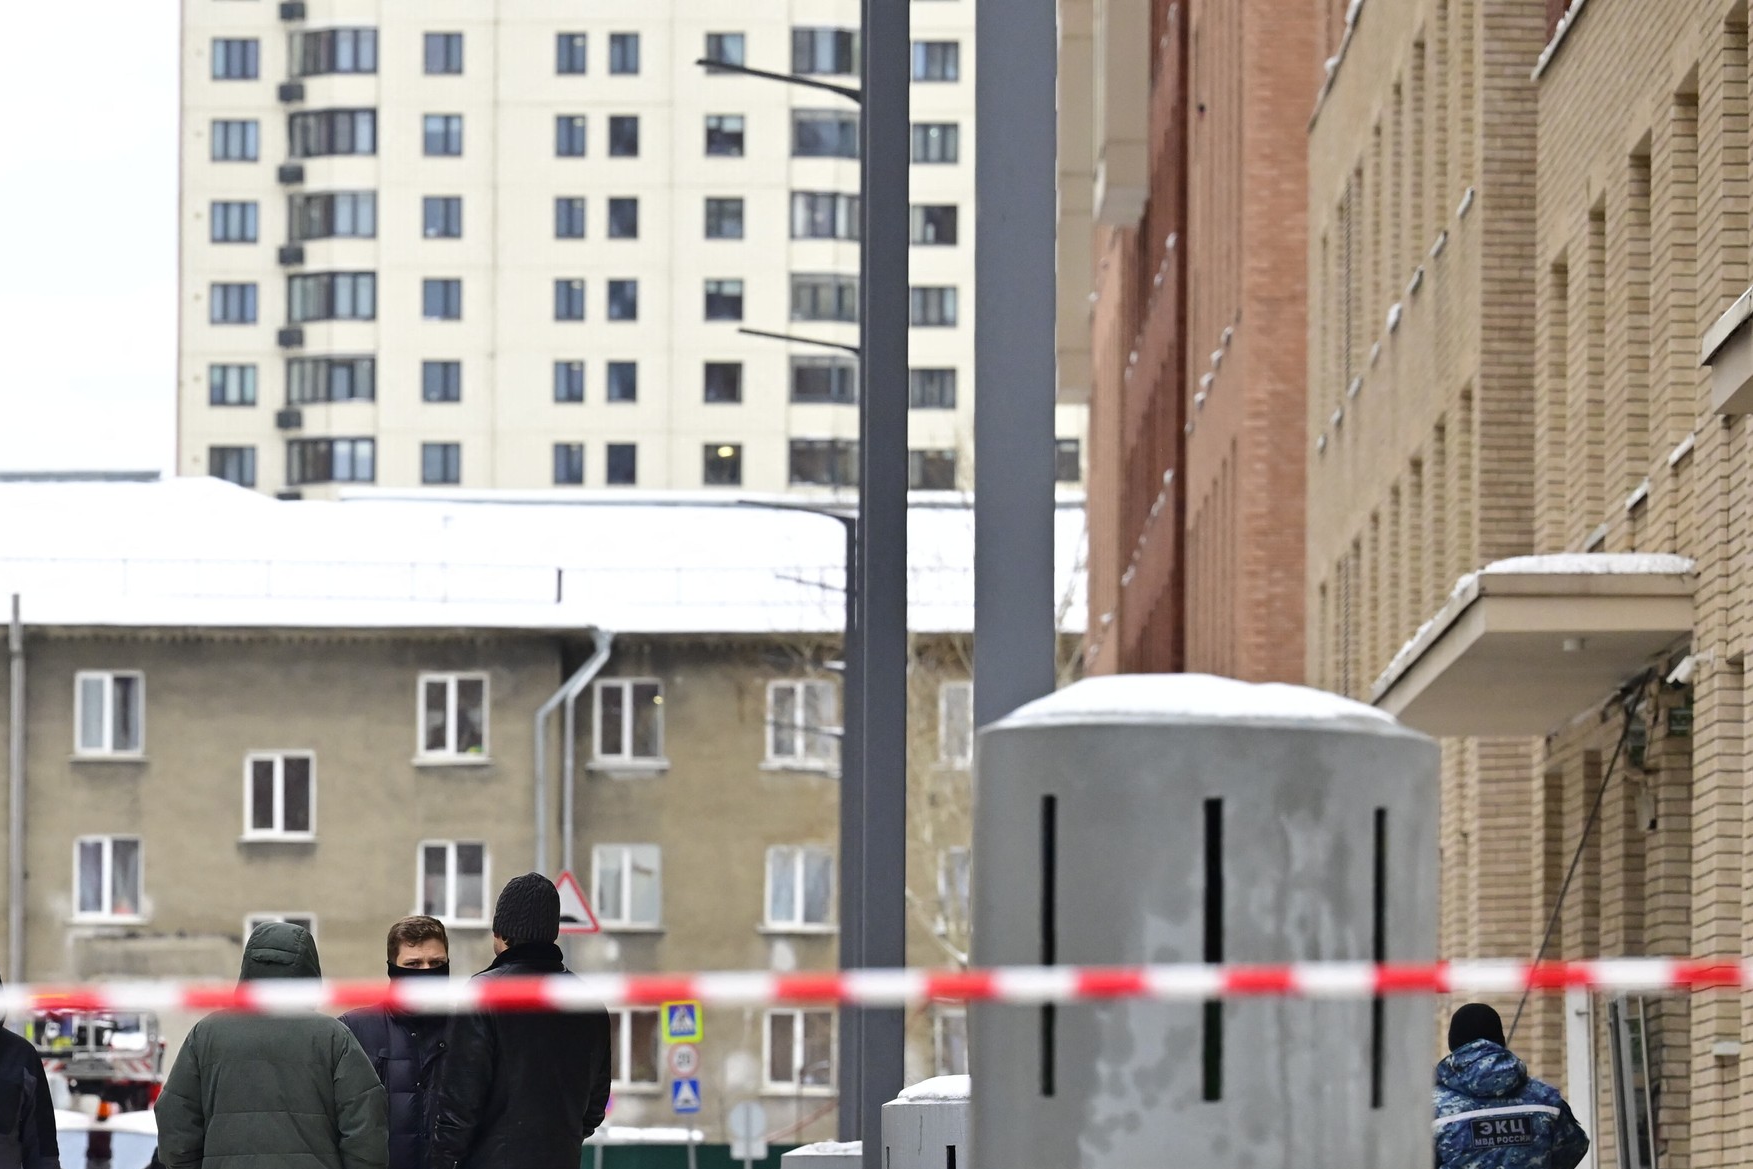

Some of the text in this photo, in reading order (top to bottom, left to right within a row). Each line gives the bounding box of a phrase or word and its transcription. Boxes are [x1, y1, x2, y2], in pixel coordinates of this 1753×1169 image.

[1479, 1118, 1525, 1135] ЭКЦ
[1474, 1134, 1531, 1146] МВД РОССИИ
